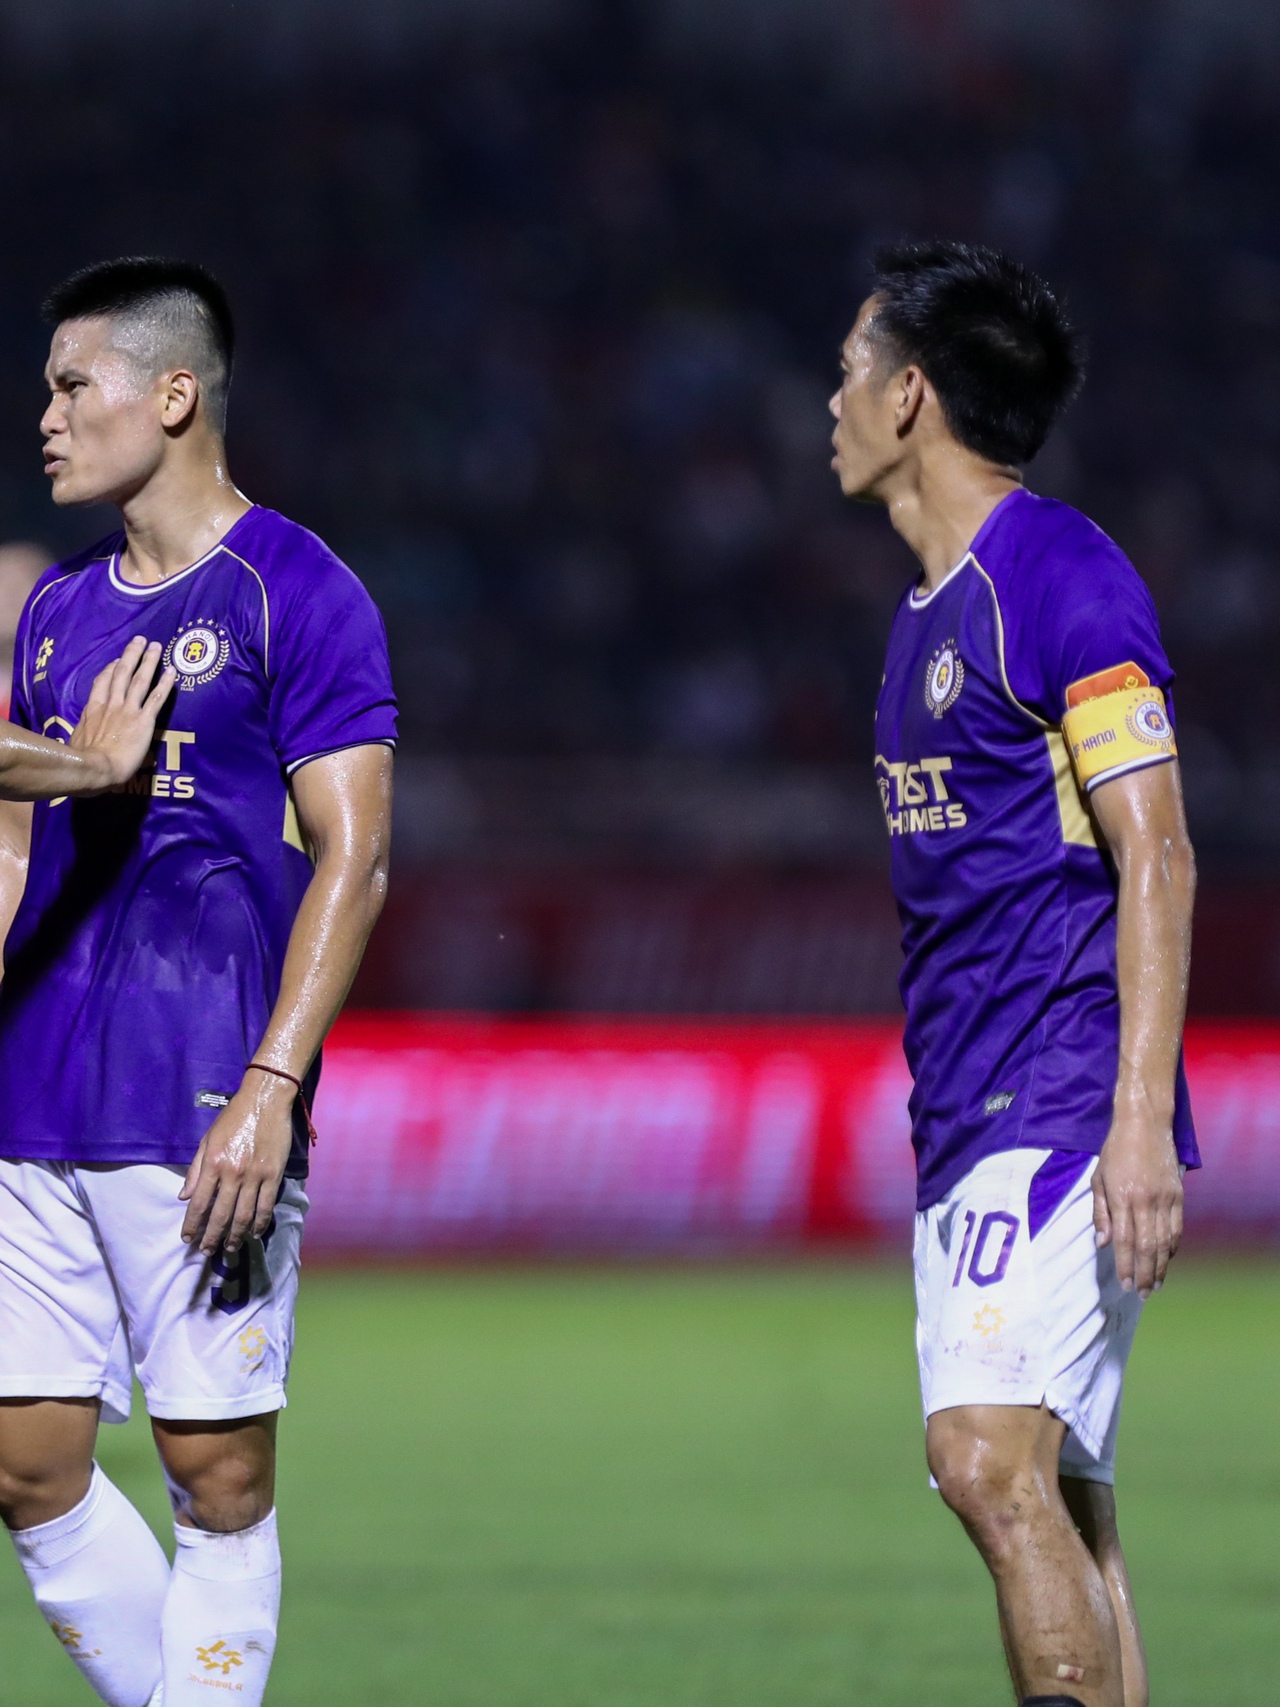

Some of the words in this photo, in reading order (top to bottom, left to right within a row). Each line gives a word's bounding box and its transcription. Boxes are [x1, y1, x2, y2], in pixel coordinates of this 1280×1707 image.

[180, 675, 196, 688] 20
[1081, 728, 1117, 753] HANOI
[888, 756, 953, 807] T&T
[890, 803, 967, 836] HOMES
[952, 1209, 1020, 1288] 10
